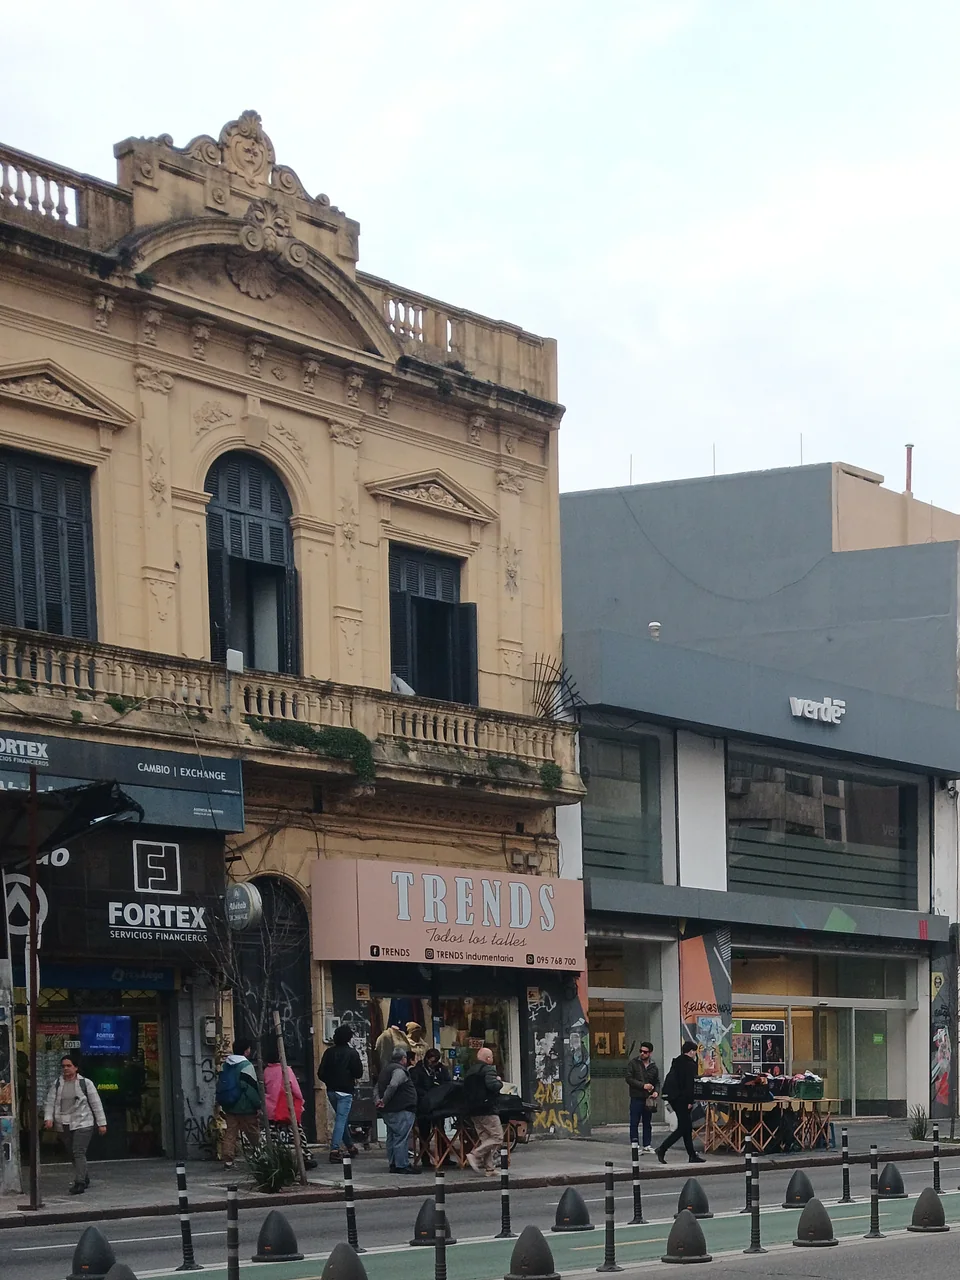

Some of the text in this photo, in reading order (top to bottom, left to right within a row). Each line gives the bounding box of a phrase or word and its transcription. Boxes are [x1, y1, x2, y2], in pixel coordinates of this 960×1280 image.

[0, 737, 49, 758] ORTEX
[137, 762, 226, 781] CAMBIO EXCHANGE
[391, 870, 556, 932] TRENDS
[108, 901, 207, 929] FORTEX
[109, 930, 208, 943] SERVICIOS FINANCIEROS
[425, 927, 527, 948] Todos los talles
[381, 946, 411, 957] TRENDS
[437, 950, 464, 961] TRENDS
[536, 955, 577, 967] 095 768 700
[750, 1023, 777, 1032] AGOSTO
